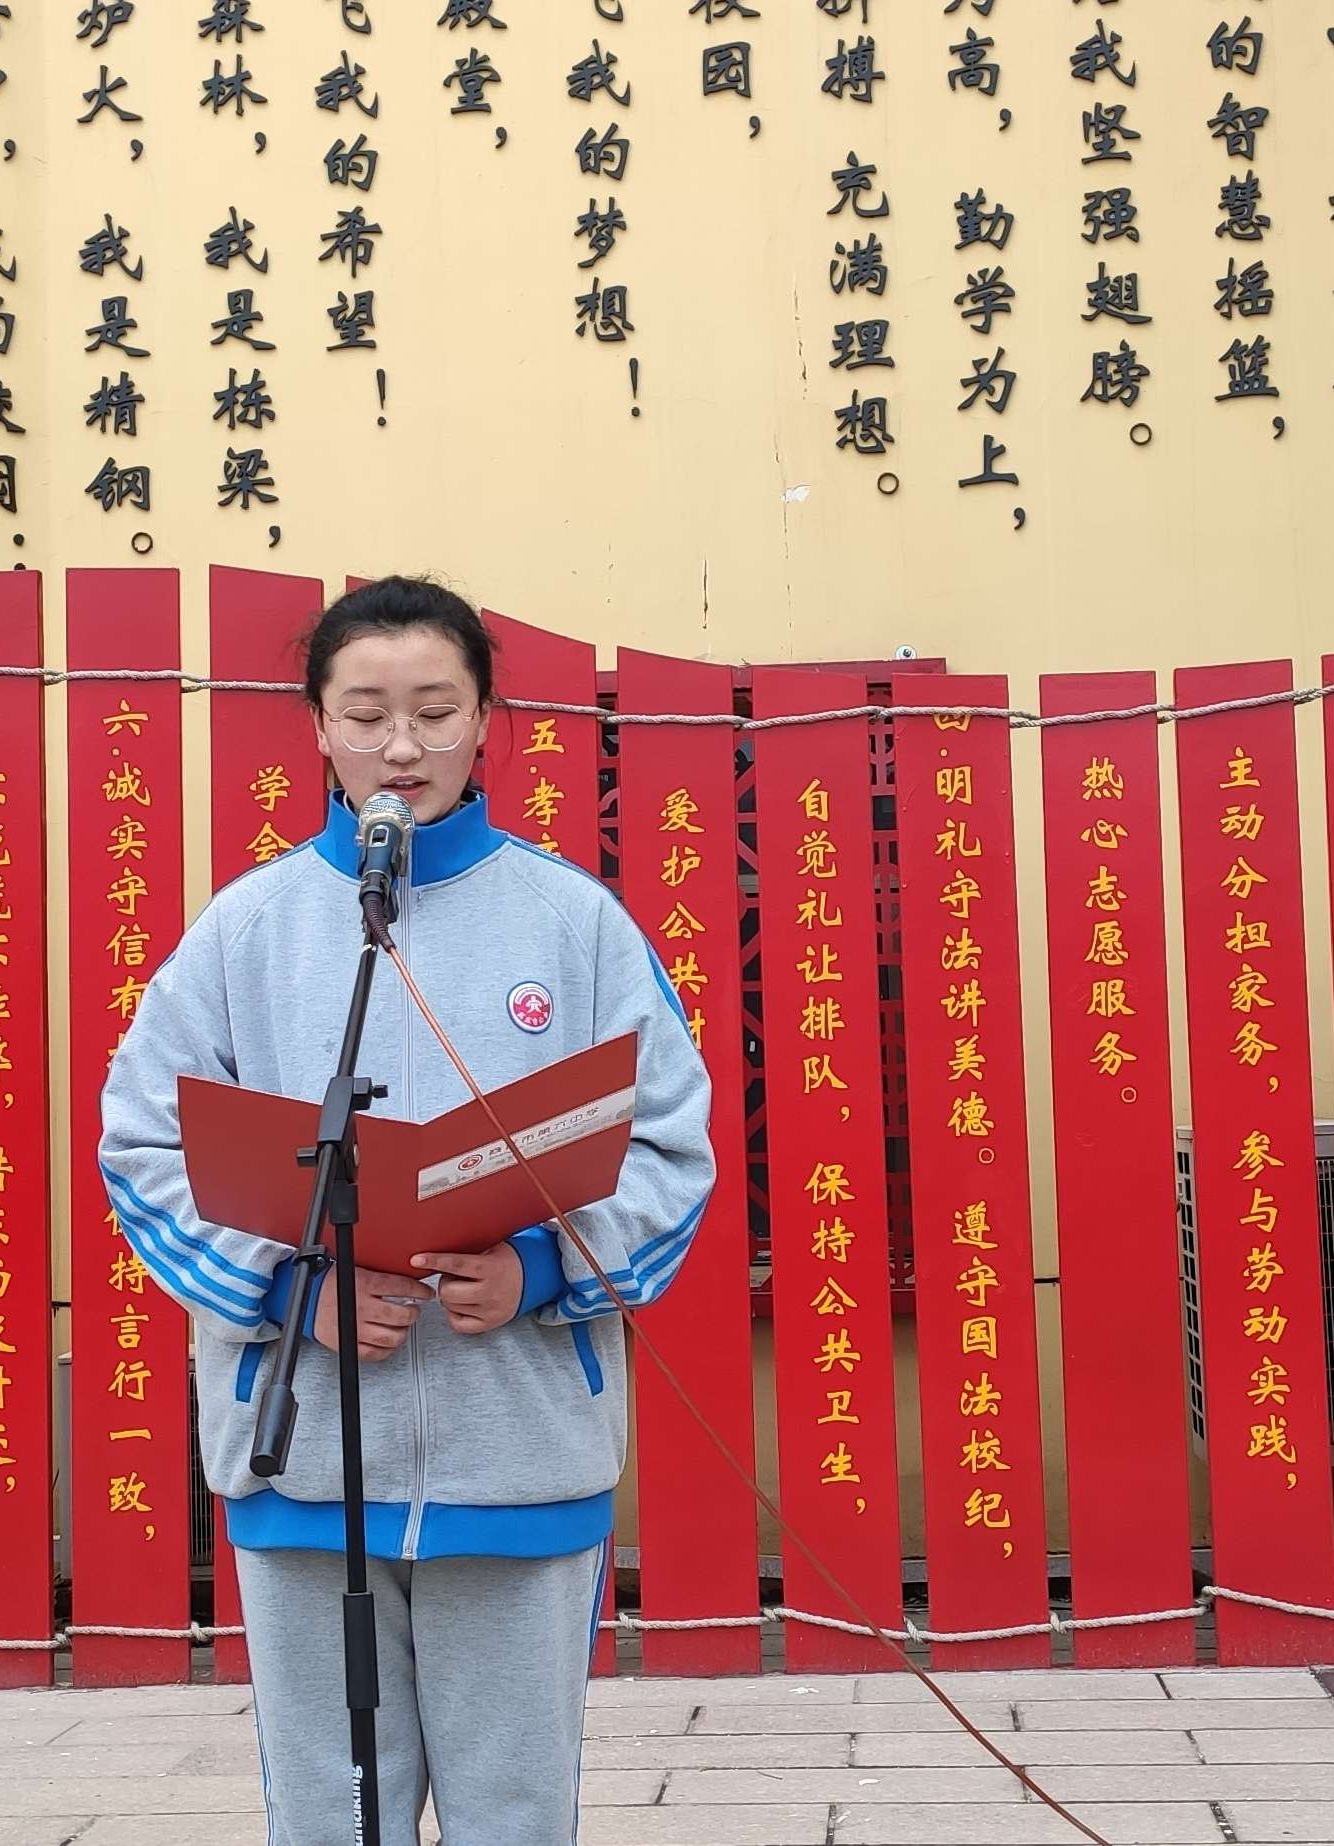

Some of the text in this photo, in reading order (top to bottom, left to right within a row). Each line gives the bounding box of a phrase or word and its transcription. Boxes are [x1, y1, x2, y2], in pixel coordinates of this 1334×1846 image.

[944, 0, 1025, 530] 高，勤学为上，
[1070, 0, 1152, 446] 我坚强翅膀。
[1081, 757, 1136, 1102] 热心志愿服务。
